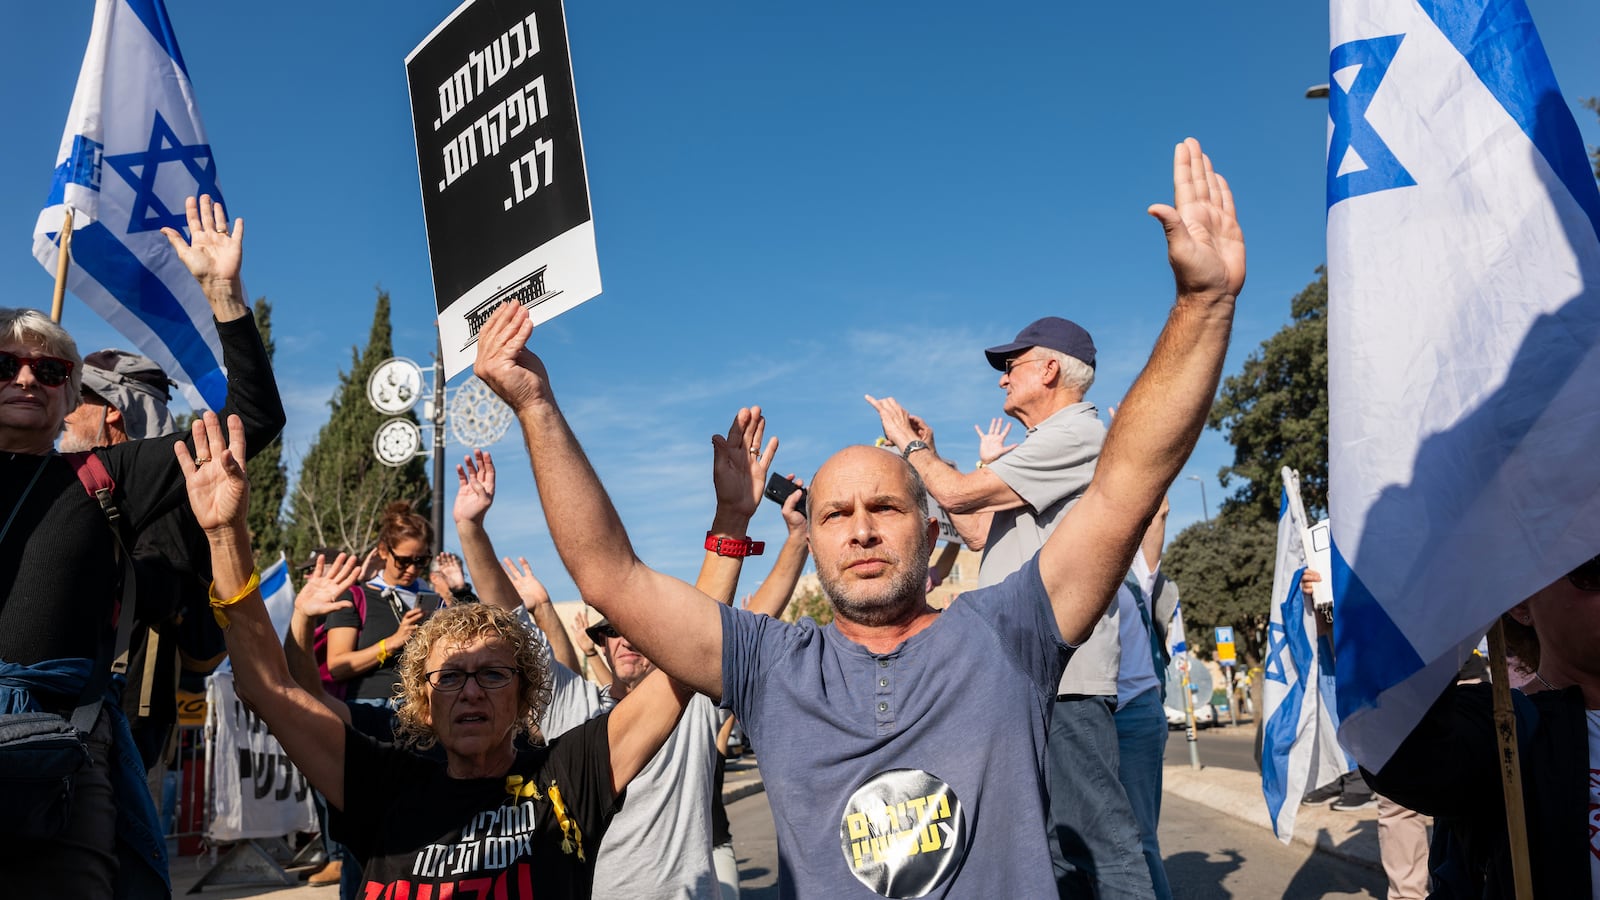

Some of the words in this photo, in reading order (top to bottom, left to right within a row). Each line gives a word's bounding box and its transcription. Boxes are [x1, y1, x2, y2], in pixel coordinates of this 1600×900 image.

[434, 11, 541, 132] נכשלתם.
[438, 74, 549, 193] הפקרתם.
[503, 137, 554, 212] לכו.
[412, 840, 482, 878] הביתה
[484, 831, 534, 870] אותם
